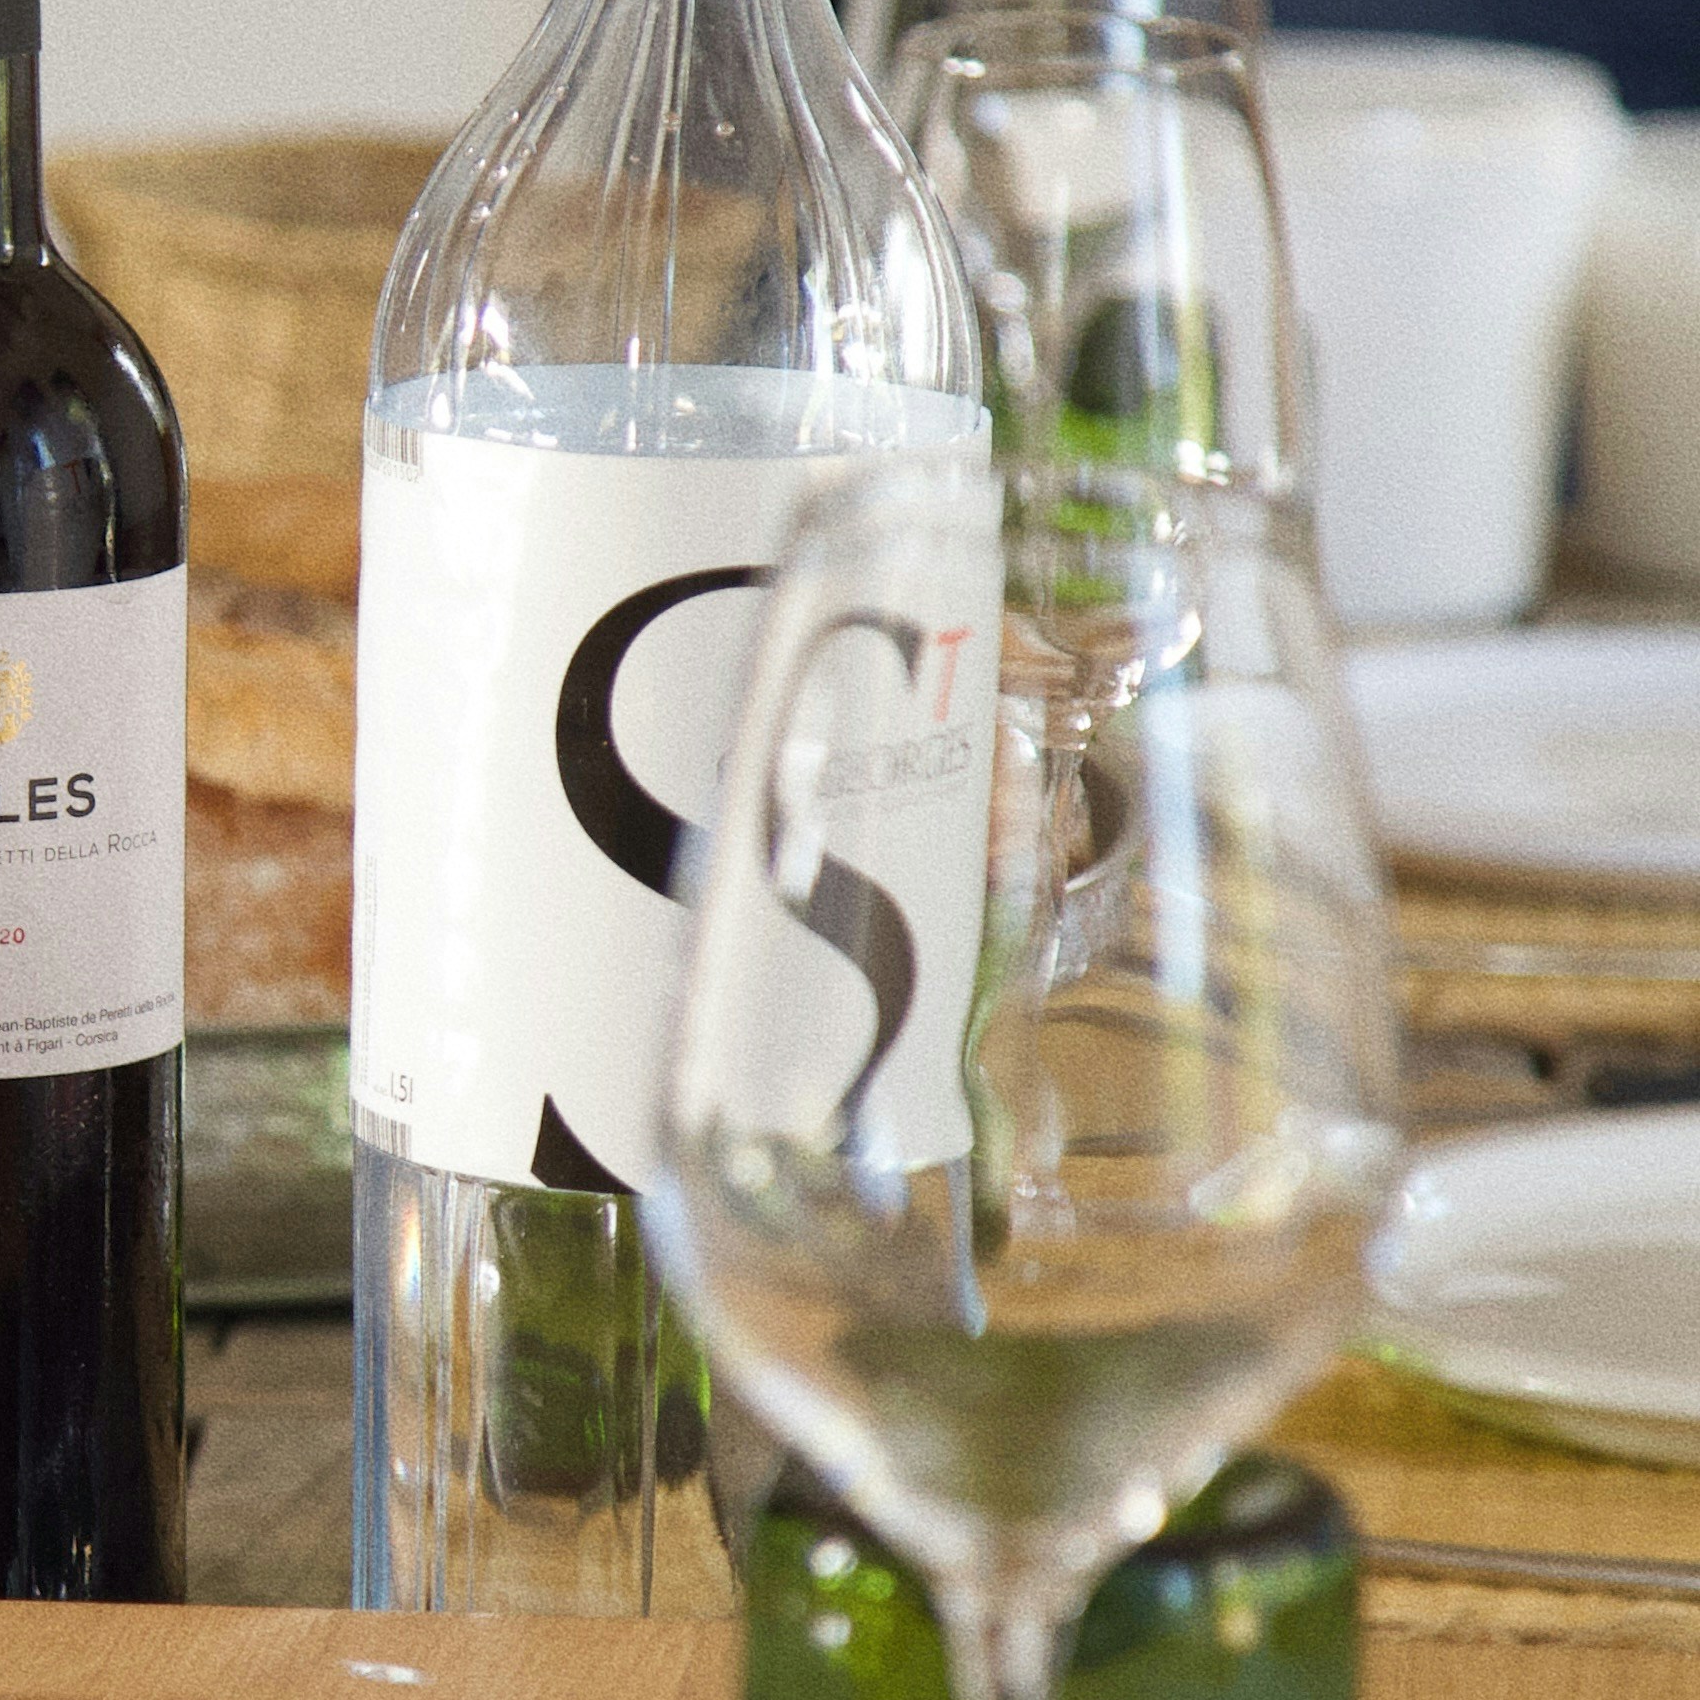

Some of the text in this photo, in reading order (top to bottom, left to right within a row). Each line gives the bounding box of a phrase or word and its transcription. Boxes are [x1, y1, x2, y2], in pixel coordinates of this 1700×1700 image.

[82, 1011, 96, 1024] de
[99, 1006, 133, 1022] Peretti
[13, 1038, 24, 1052] à
[27, 1035, 63, 1054] Figari
[75, 1029, 118, 1047] Corsica
